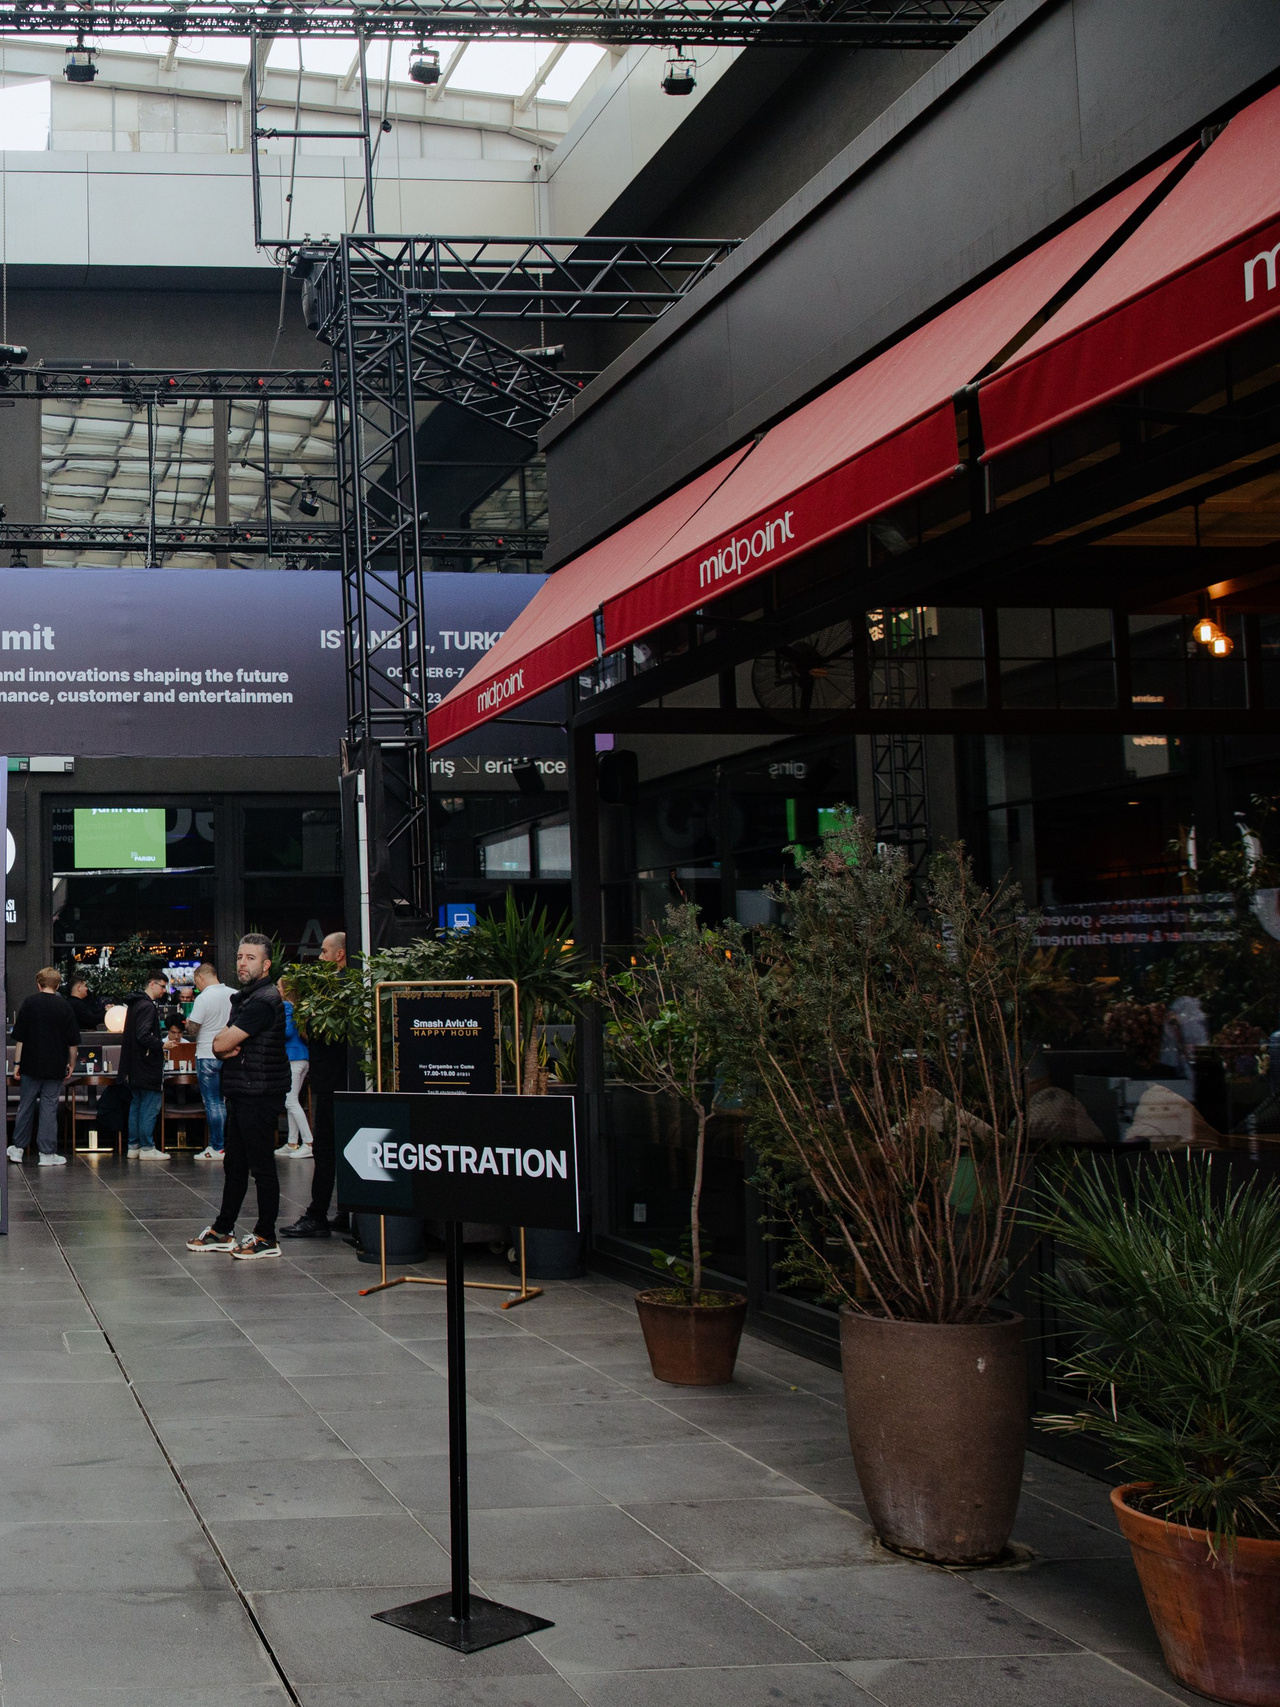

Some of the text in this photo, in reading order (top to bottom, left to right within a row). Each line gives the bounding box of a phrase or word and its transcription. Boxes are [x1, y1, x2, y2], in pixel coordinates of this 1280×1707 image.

[699, 510, 795, 588] midpoint
[320, 629, 436, 654] ISANBU,
[28, 666, 131, 682] innovations
[133, 667, 202, 686] shaping
[204, 668, 234, 683] the
[236, 668, 289, 683] future
[445, 667, 465, 678] 6-7
[57, 689, 141, 703] customer
[143, 688, 175, 703] and
[178, 688, 293, 703] entertainmen
[477, 668, 525, 714] midpoint
[413, 1019, 444, 1028] Smash
[413, 1029, 479, 1037] HAPPY HOUR
[367, 1141, 568, 1179] REGISTRATION
